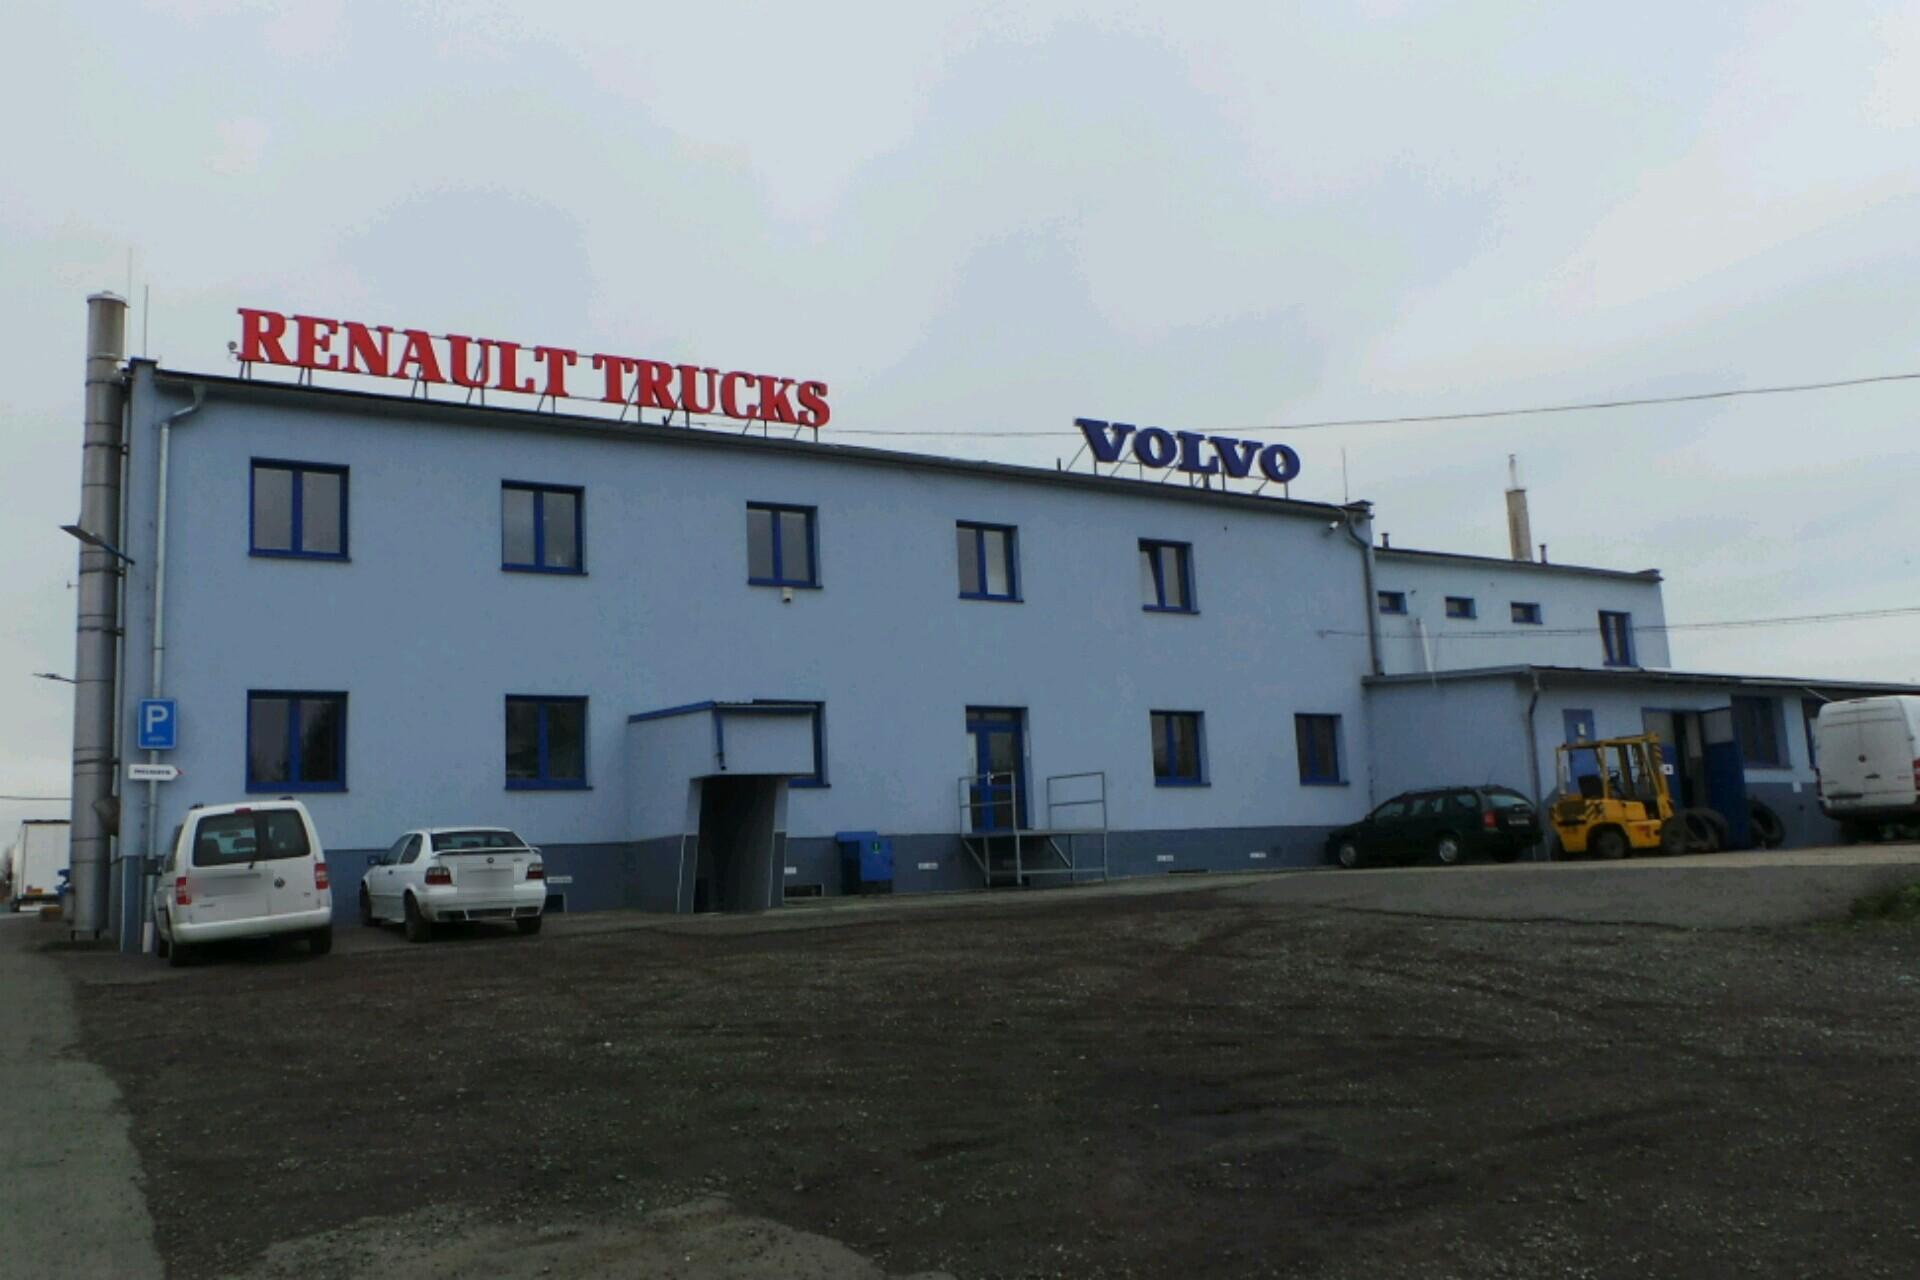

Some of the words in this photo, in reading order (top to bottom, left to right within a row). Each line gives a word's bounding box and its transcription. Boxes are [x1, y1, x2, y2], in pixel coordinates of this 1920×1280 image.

[237, 308, 576, 397] RENAULT
[593, 353, 830, 428] TRUCKS
[1075, 418, 1300, 483] VOLVO
[146, 705, 168, 733] P
